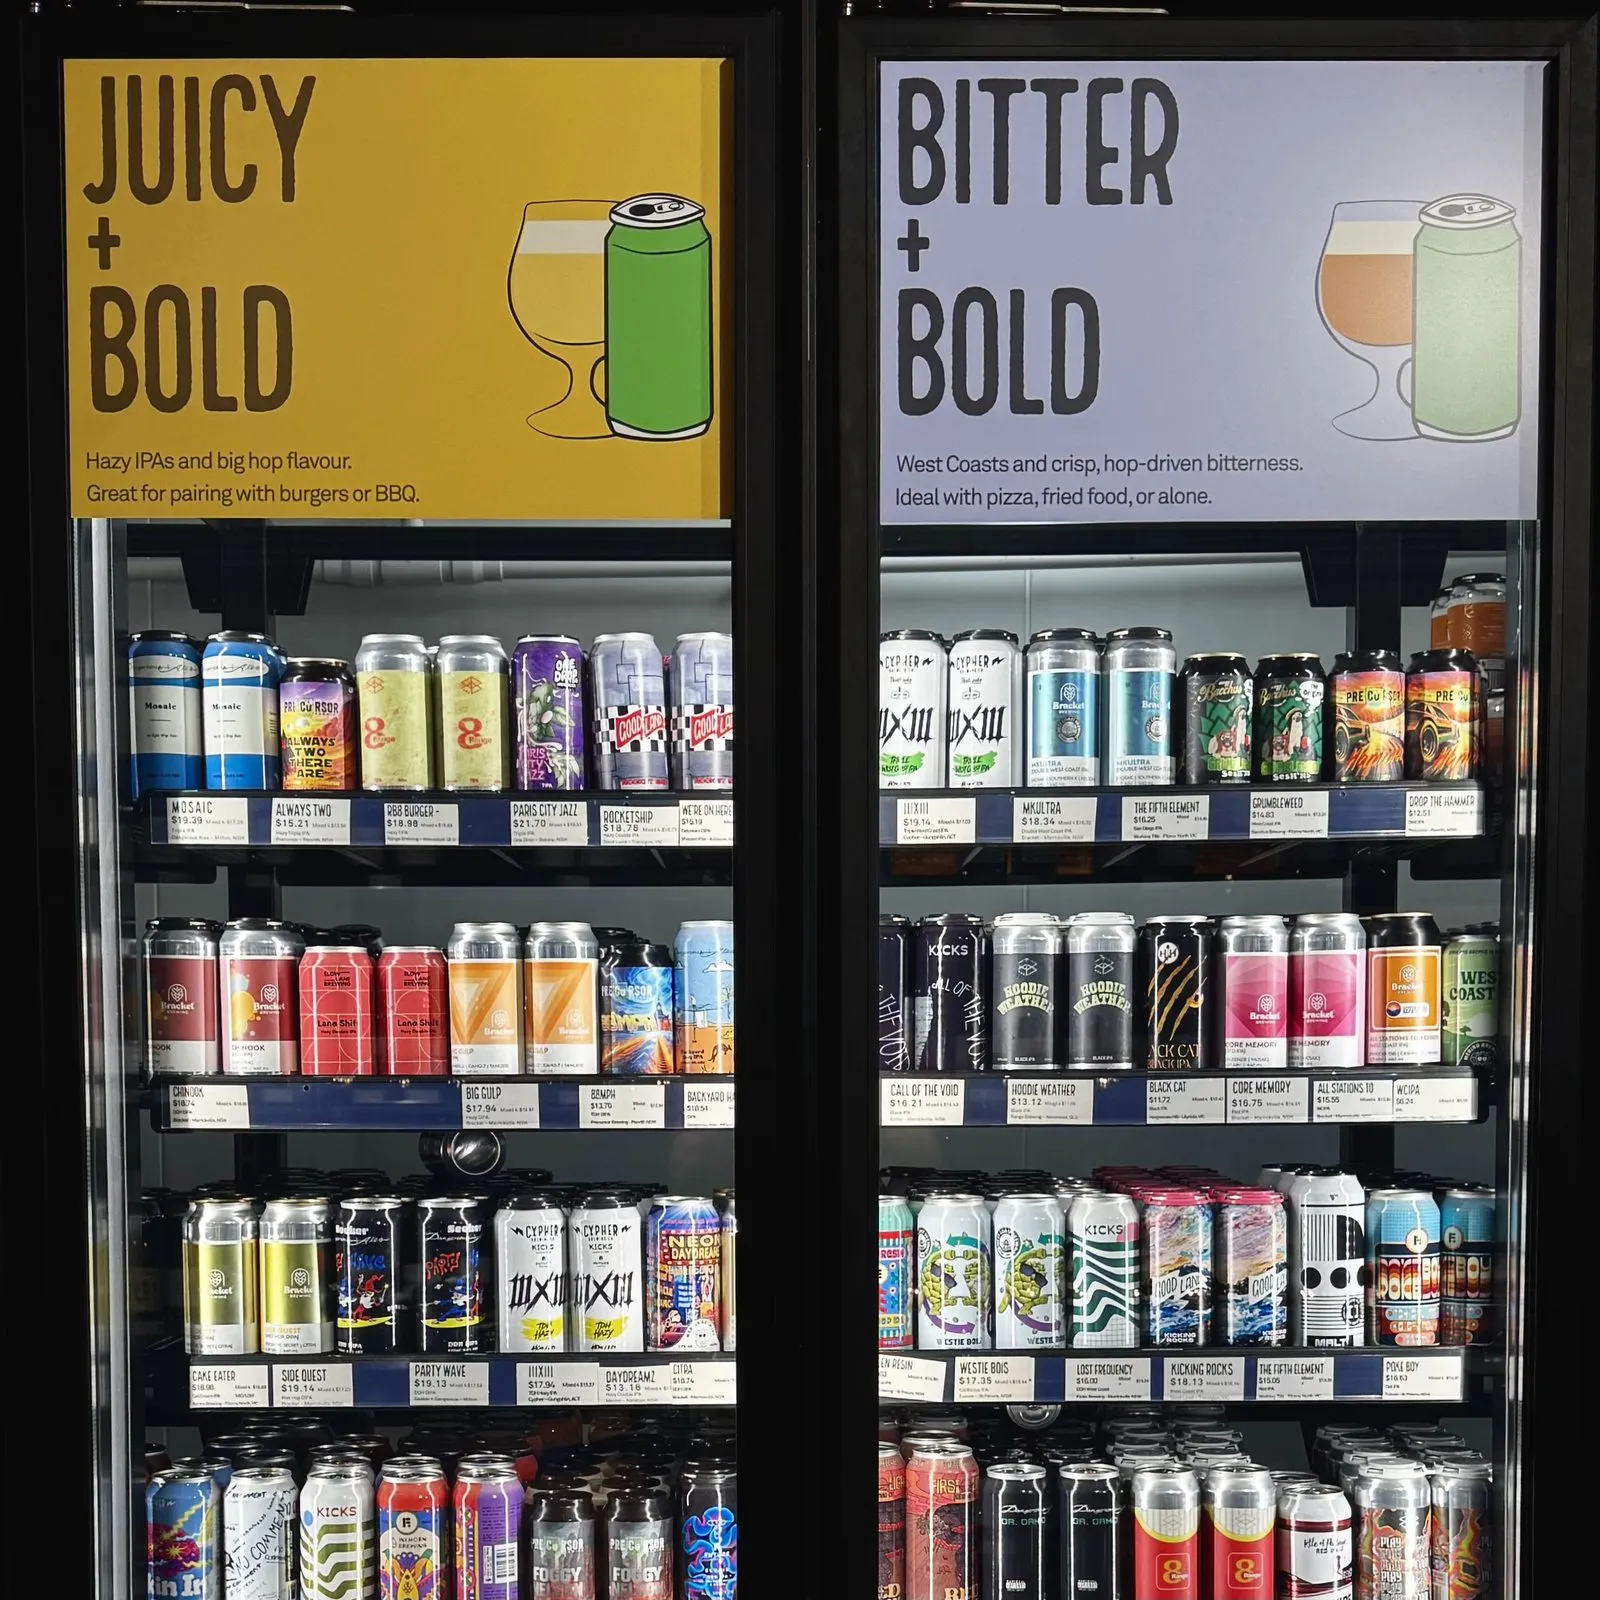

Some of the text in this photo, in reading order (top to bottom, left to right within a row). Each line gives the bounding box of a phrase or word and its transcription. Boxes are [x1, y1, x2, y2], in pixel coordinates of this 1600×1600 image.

[83, 74, 316, 205] JUICY
[898, 78, 1179, 205] BITTER
[88, 217, 120, 270] +
[897, 219, 929, 272] +
[90, 284, 293, 413] BOLD
[898, 287, 1100, 416] BOLD
[87, 452, 351, 474] Hazy IPAs and big hop flavour.
[897, 454, 1303, 476] West Coasts and crisp, hop-driven bitterness.
[87, 484, 419, 506] Great for pairing with burgers or BBQ.
[897, 487, 1211, 510] Ideal with pizza, fried food, or alone.
[145, 702, 176, 710] Mosaic
[618, 714, 642, 742] GOOD
[286, 736, 335, 746] ALWAYS
[295, 748, 326, 757] TWO
[290, 758, 332, 768] THERE
[297, 770, 324, 778] ARE
[1253, 797, 1303, 808] GRUMBLEWEED
[1410, 795, 1474, 807] DROP THE HAMMER
[170, 800, 212, 815] MOSAIC
[276, 804, 331, 817] ALWAYS TWO
[388, 803, 433, 817] RB8 BURGER
[514, 802, 577, 816] PARIS CITY JAZZ
[704, 805, 714, 816] ON
[904, 802, 928, 814] IIIXIII
[1023, 802, 1061, 814] MKULTRA
[1135, 802, 1199, 813] THE FIFTH ELEMENT
[170, 815, 202, 825] $19.39
[276, 819, 308, 827] $15.21
[387, 819, 418, 827] $18.98
[604, 811, 653, 824] ROCKETSHIP
[904, 818, 930, 826] $19.14
[1022, 817, 1055, 825] $18.34
[603, 823, 638, 832] $18.78
[1004, 982, 1049, 997] HOODIE
[1450, 988, 1496, 1000] COAST
[172, 1086, 203, 1098] CHINOOK
[891, 1084, 958, 1096] CALL OF THE VOID
[1012, 1084, 1075, 1096] HOODIE WEATHER
[1150, 1081, 1186, 1092] BLACK CAT
[1233, 1081, 1290, 1094] CORE MEMORY
[1318, 1081, 1373, 1094] ALL STATIONS TO
[1397, 1085, 1419, 1095] WCIPA
[466, 1087, 501, 1099] BIG GULP
[688, 1091, 724, 1102] BACKYARD
[1232, 1099, 1262, 1107] $16.75
[526, 1225, 558, 1238] CYPHER
[584, 1224, 618, 1236] CYPHER
[1085, 1225, 1123, 1235] KICKS
[596, 1322, 611, 1330] TDH
[594, 1328, 614, 1340] HAZY
[673, 1363, 692, 1374] CITRA
[892, 1359, 913, 1370] RESIN
[960, 1362, 1008, 1374] WESTIE BOIS
[1077, 1364, 1133, 1375] LOST FREQUENCY
[1171, 1363, 1233, 1375] KICKING ROCKS
[1260, 1363, 1324, 1375] THE FIFTH ELEMENT
[1386, 1361, 1419, 1372] POKE BOY
[193, 1371, 235, 1381] CAKE EATER
[282, 1369, 326, 1381] SIDE QUEST
[415, 1365, 465, 1377] PARTY WAVE
[529, 1366, 553, 1377] IIIXIII
[606, 1371, 655, 1383] DAYDREAMZ
[282, 1384, 314, 1392] $19.14
[528, 1381, 555, 1389] $17.94
[317, 1506, 356, 1517] KICKS
[534, 1568, 581, 1581] FOGGY
[613, 1567, 662, 1580] FOGGY
[1163, 1560, 1182, 1584] 8
